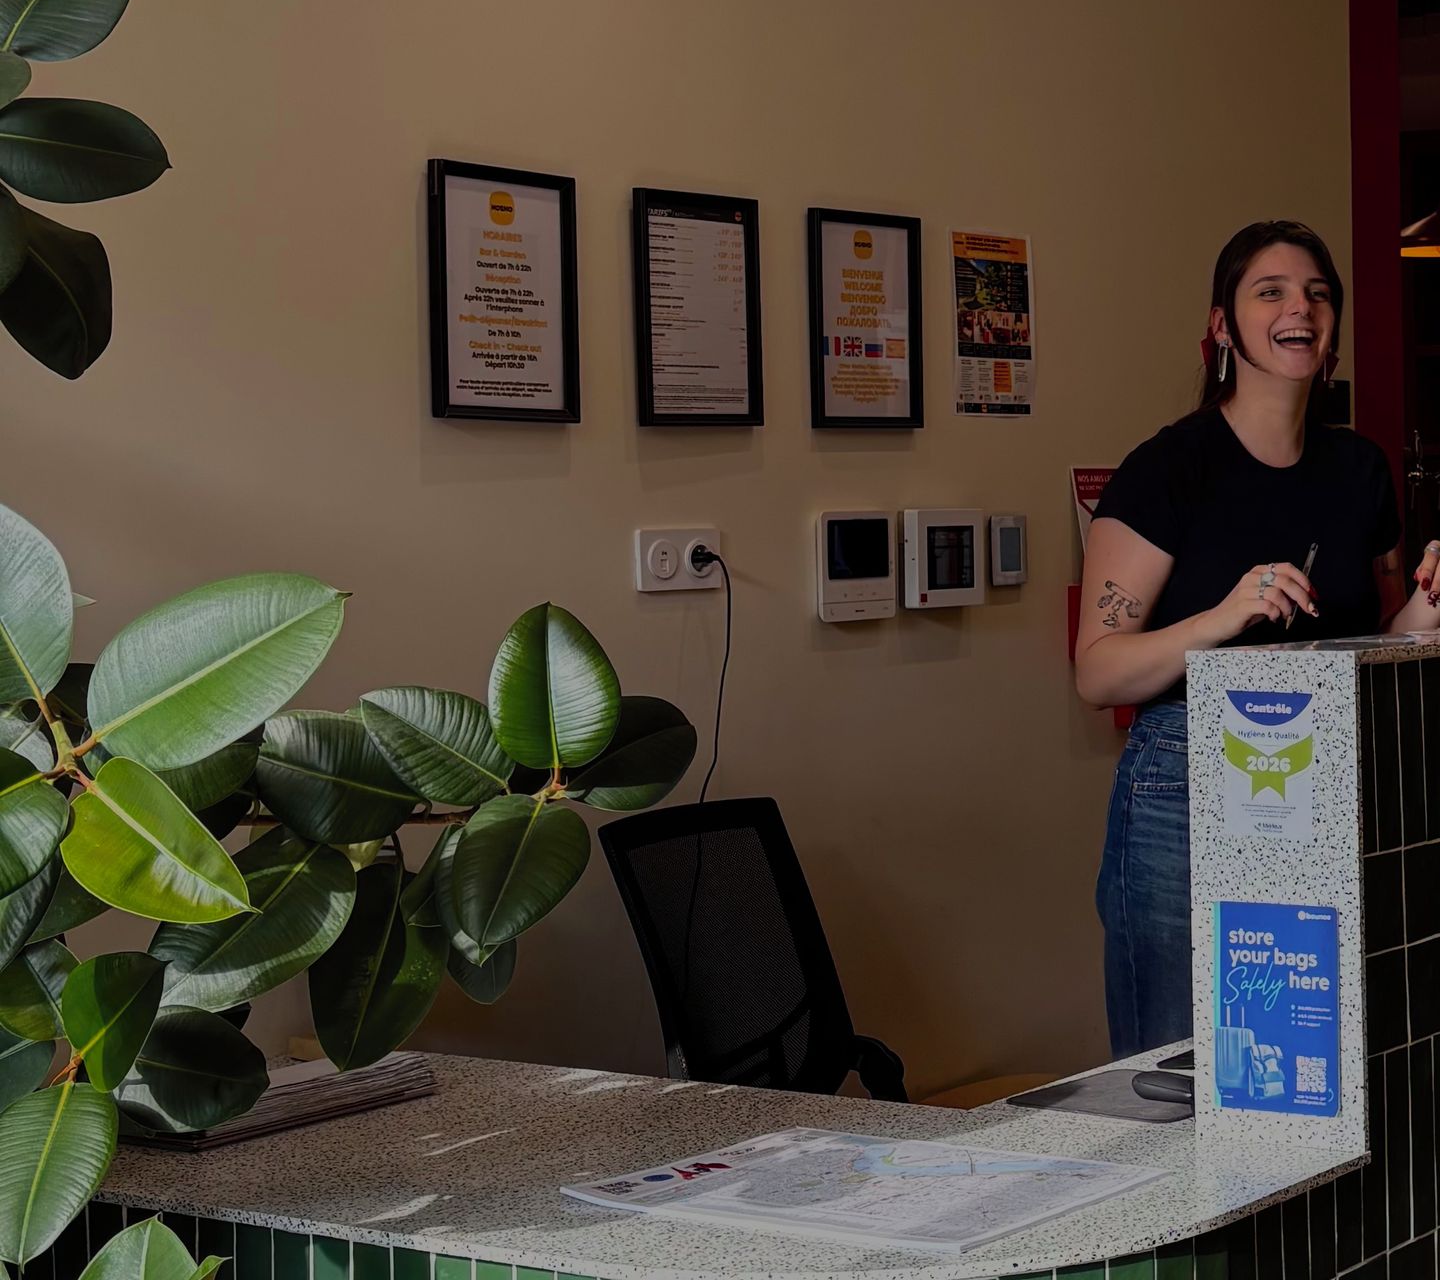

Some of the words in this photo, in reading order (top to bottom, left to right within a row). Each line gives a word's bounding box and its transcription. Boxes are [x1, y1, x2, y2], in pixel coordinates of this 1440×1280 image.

[483, 231, 523, 242] HORAIRES
[477, 261, 498, 269] Ouvert
[516, 263, 521, 271] à
[521, 264, 532, 272] 22h
[842, 269, 884, 280] BIENVENUE
[475, 287, 501, 295] Ouverte
[518, 289, 523, 297] à
[843, 281, 883, 292] WELCOME
[464, 294, 483, 304] Après
[496, 297, 519, 305] veuillez
[841, 293, 886, 304] BIENVENIDO
[850, 305, 878, 317] ДОБРО
[837, 317, 892, 329] ПОЖАЛОВАТЬ
[472, 352, 496, 360] Arrivée
[496, 352, 501, 360] à
[501, 353, 519, 362] partir
[485, 361, 507, 370] Départ
[507, 361, 525, 369] 10h30
[1245, 703, 1292, 715] Contrôle
[1238, 730, 1266, 740] Hygiène
[1267, 731, 1273, 739] &
[1274, 732, 1300, 740] Qualité
[1246, 755, 1291, 773] 2026
[1229, 928, 1275, 946] store
[1229, 949, 1272, 968] your
[1274, 947, 1318, 972] bags
[1223, 962, 1287, 1011] Safely
[1289, 971, 1331, 991] here
